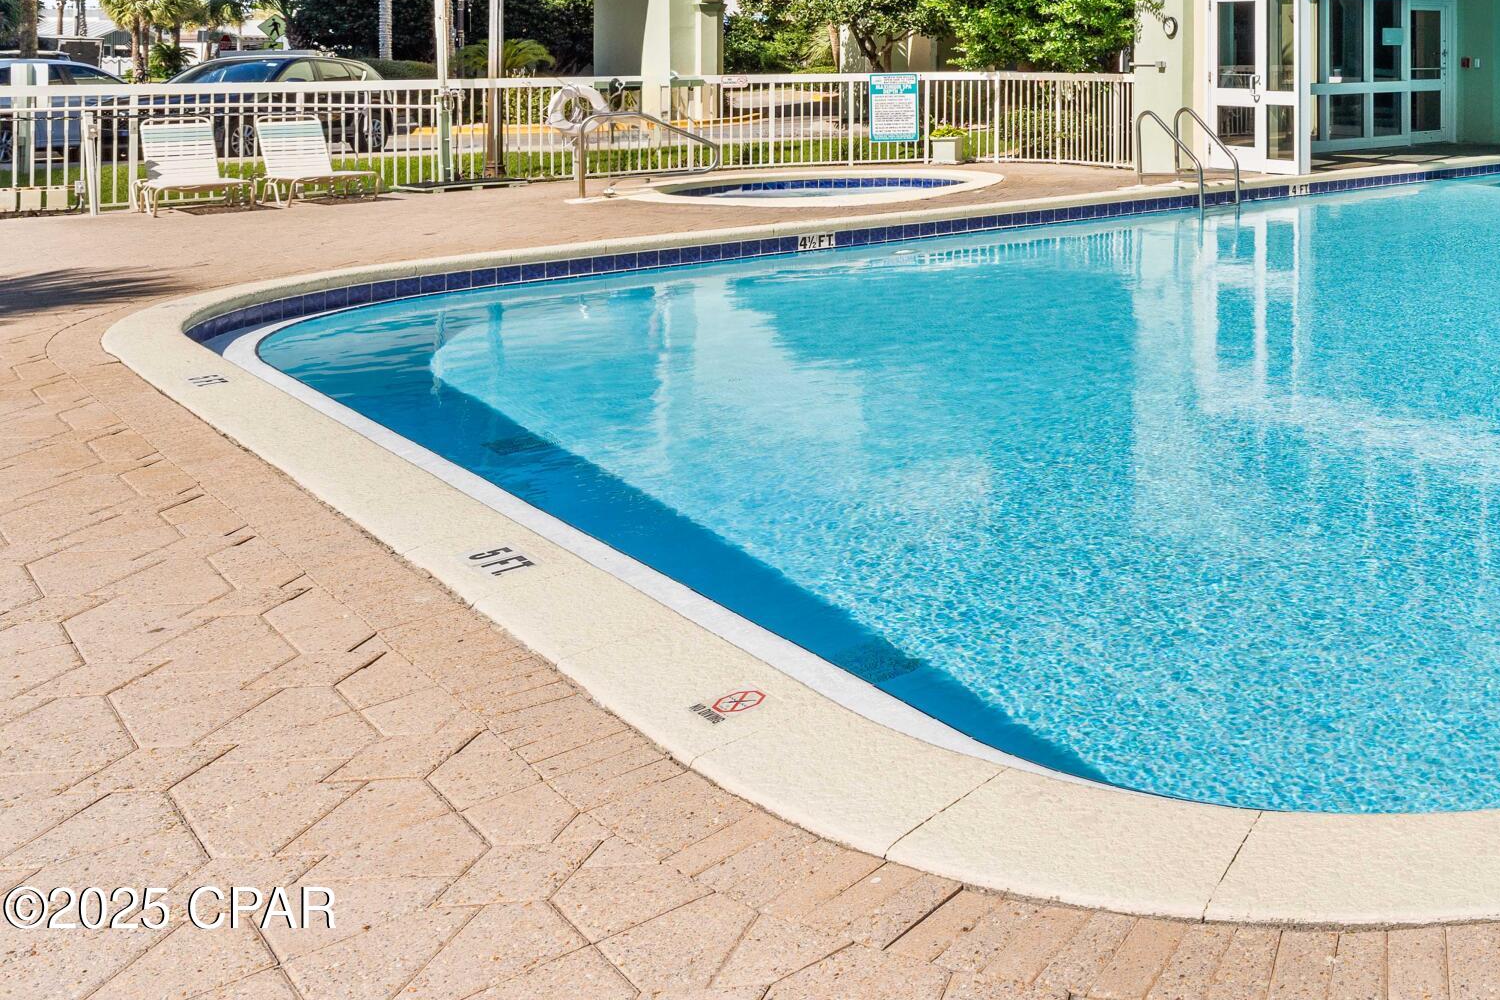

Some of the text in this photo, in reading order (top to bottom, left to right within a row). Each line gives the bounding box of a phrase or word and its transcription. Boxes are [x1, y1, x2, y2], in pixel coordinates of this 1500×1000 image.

[1291, 184, 1309, 194] 4 FT
[469, 547, 513, 560] 5
